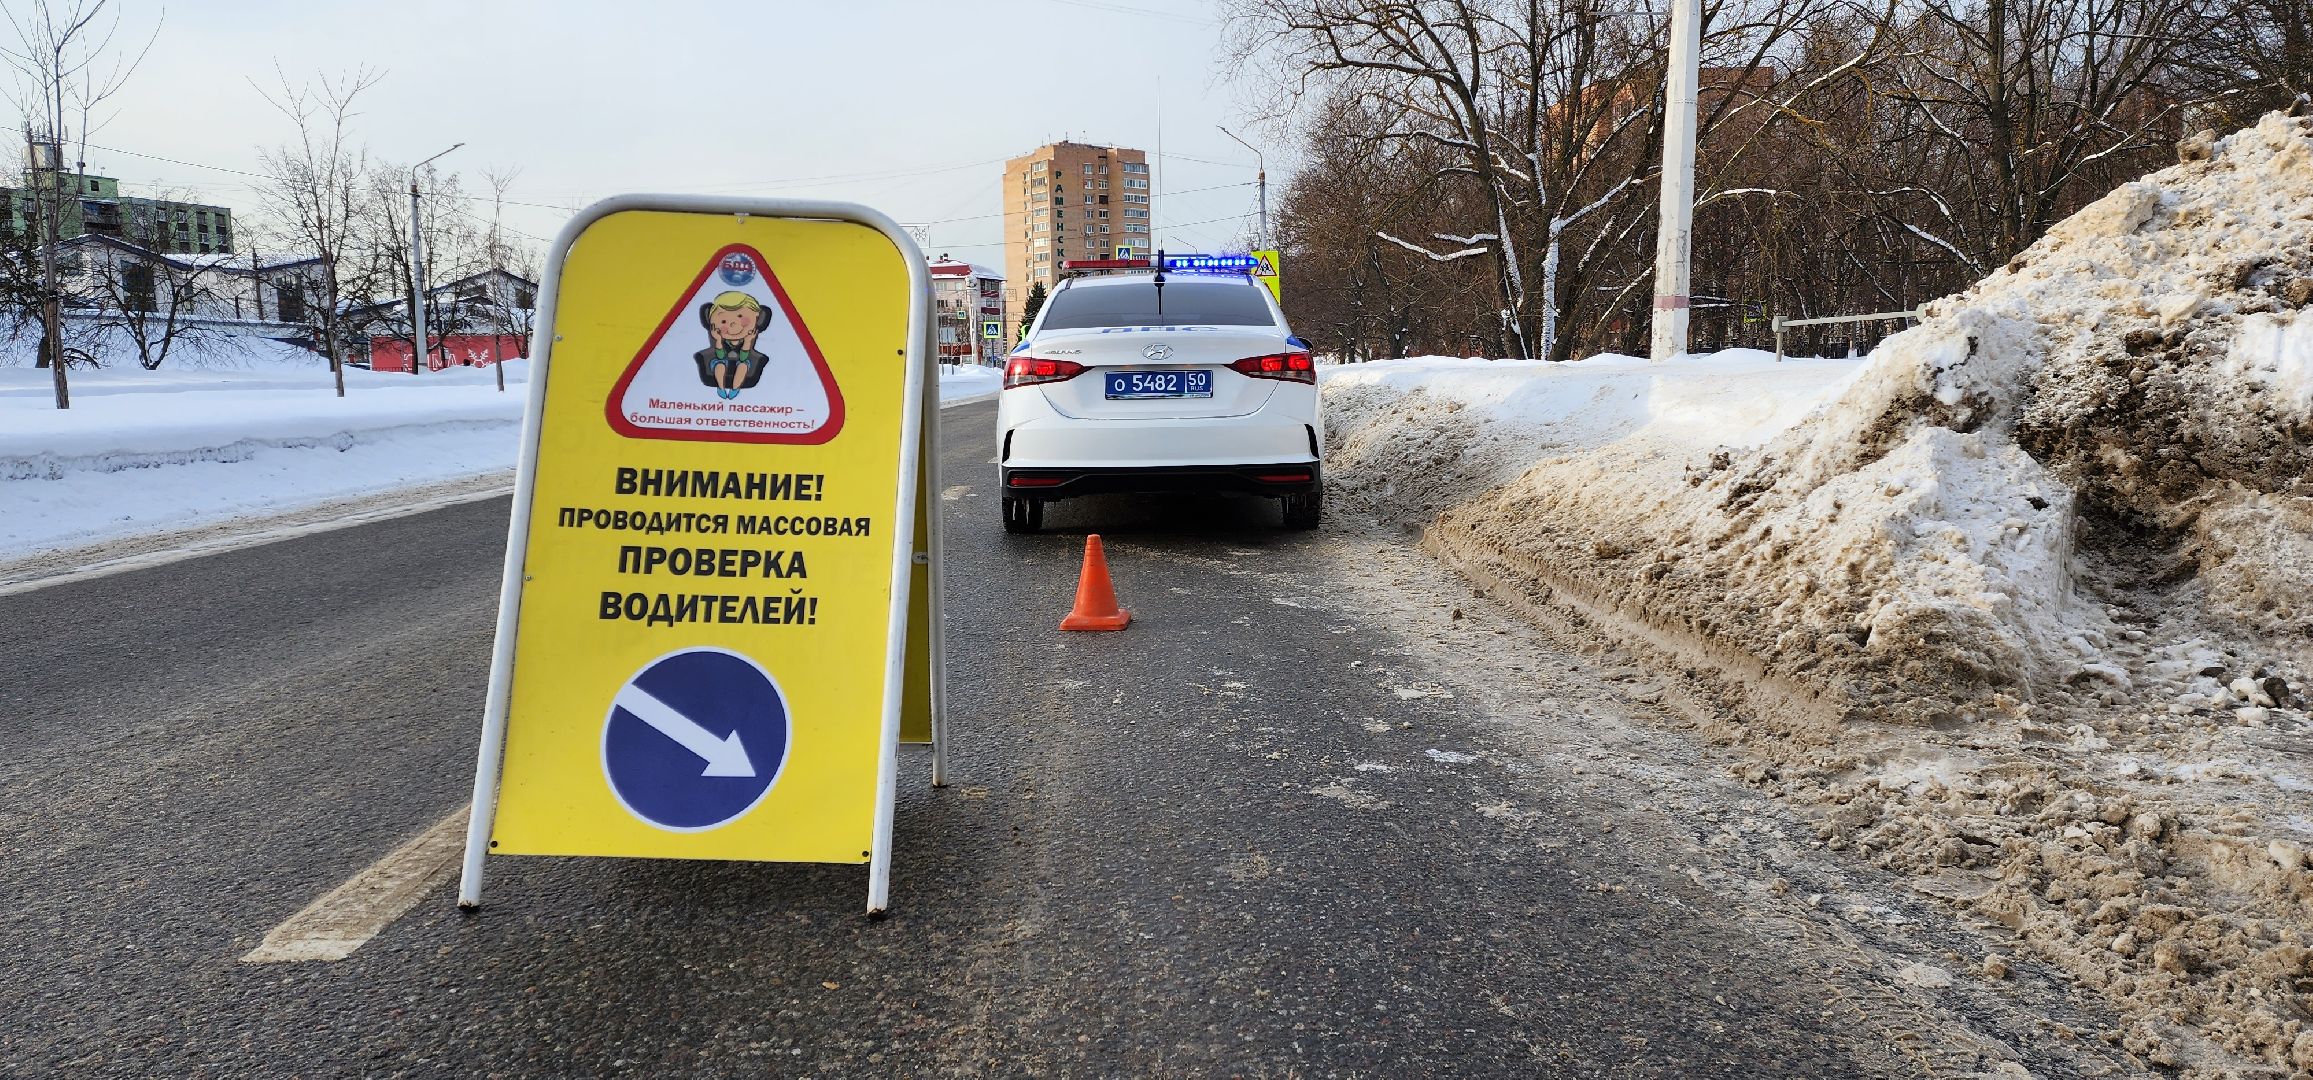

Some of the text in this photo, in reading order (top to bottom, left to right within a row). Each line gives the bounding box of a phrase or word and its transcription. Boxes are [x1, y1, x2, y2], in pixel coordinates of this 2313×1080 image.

[1132, 374, 1177, 391] 5482
[1188, 373, 1206, 386] 50
[648, 398, 724, 412] Маленький
[729, 404, 793, 416] пассажир
[630, 412, 815, 430] большая ответственность!
[614, 467, 825, 501] ВНИМАНИЕ!
[558, 507, 871, 537] ПРОВОДИТСЯ МАССОВАЯ
[617, 545, 808, 579] ПРОВЕРКА
[599, 588, 819, 627] ВОДИТЕЛЕЙ!
